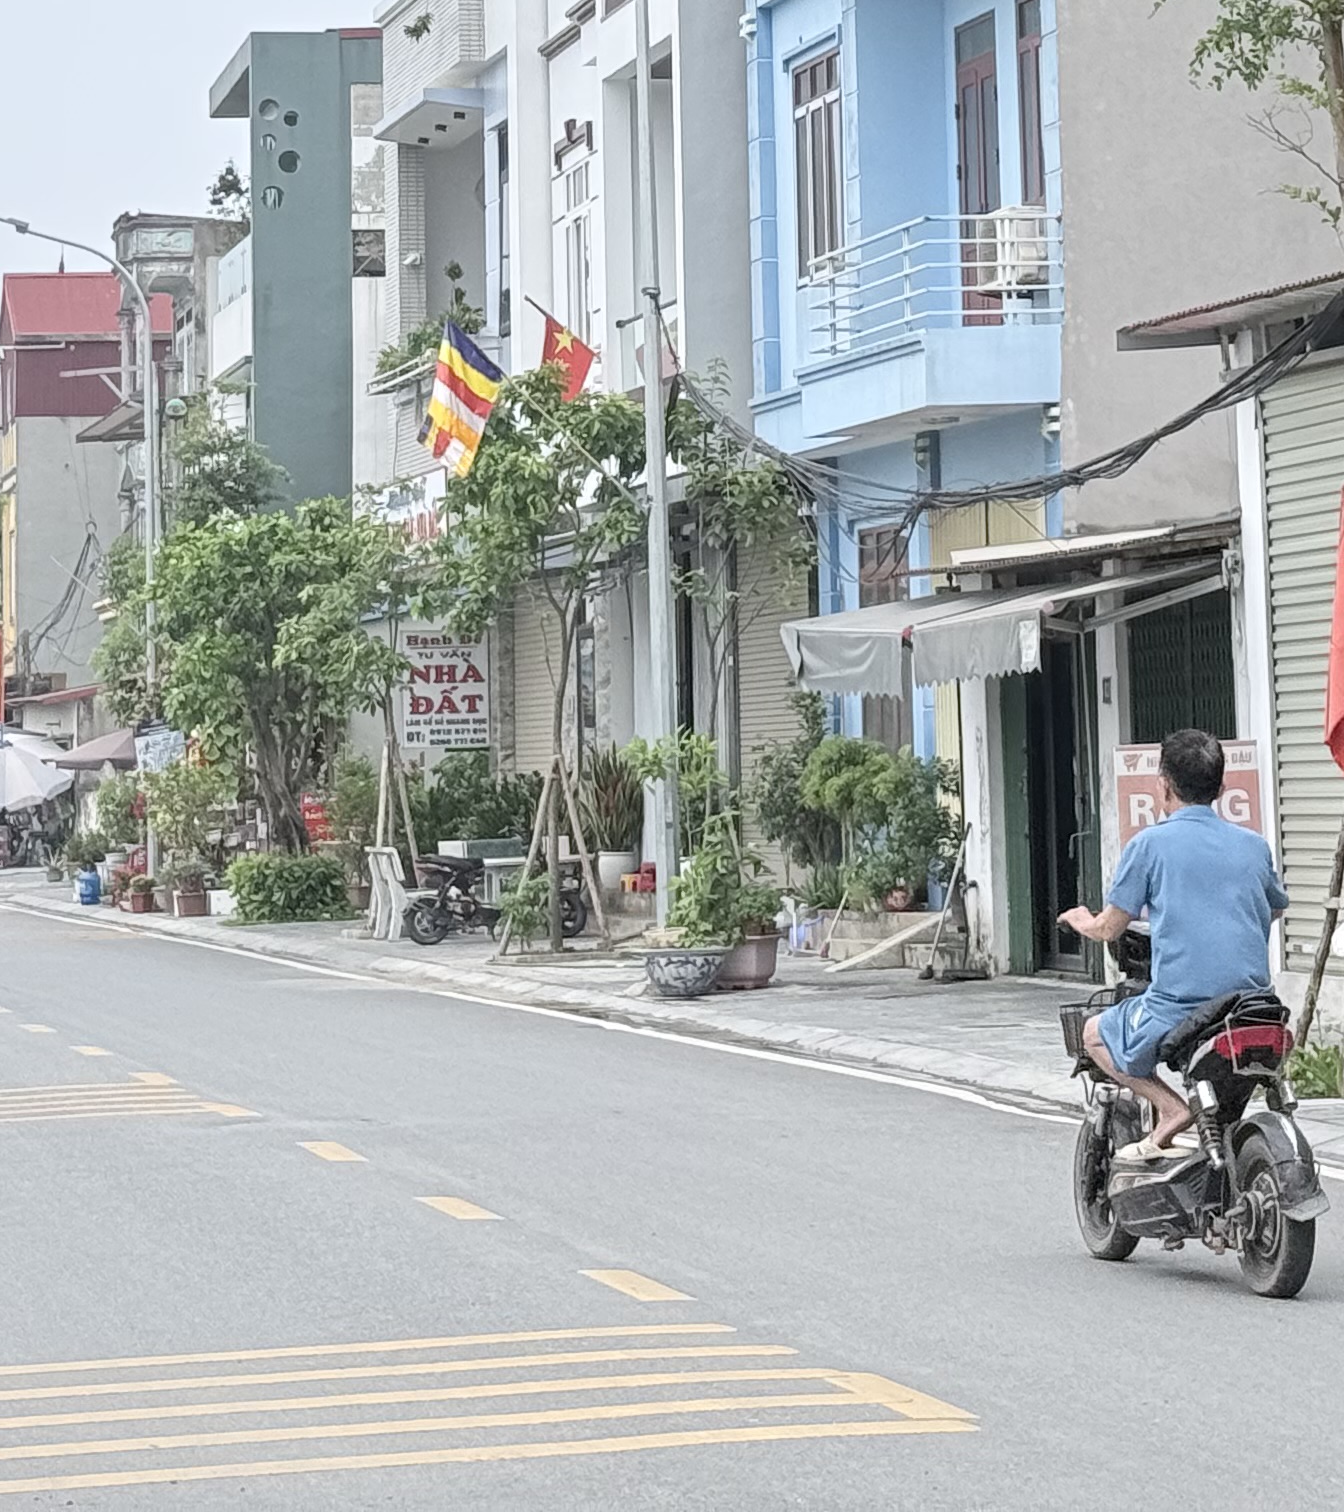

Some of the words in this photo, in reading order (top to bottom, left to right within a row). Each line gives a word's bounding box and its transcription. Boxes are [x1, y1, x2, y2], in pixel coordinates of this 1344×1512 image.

[408, 657, 485, 684] NHÀ
[409, 685, 484, 715] ĐẤT
[1129, 789, 1251, 828] RG
